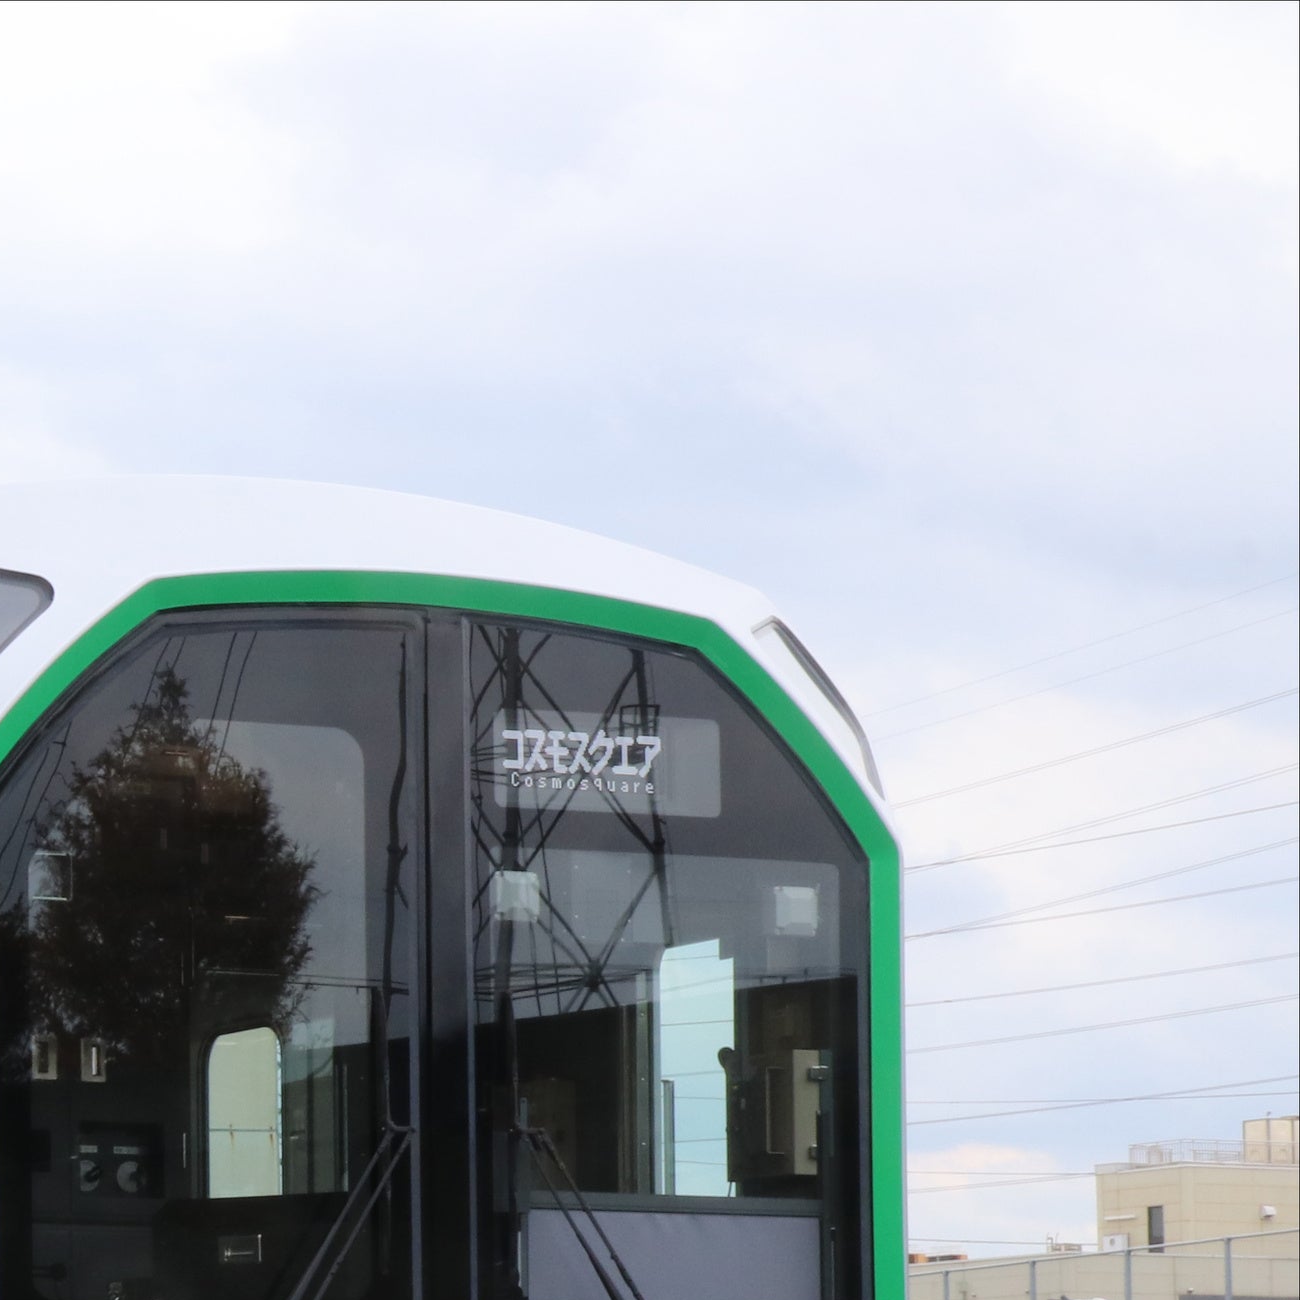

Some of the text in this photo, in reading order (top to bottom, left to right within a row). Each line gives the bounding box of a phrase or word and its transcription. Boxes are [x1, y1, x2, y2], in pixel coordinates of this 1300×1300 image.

[502, 729, 662, 778] コスモスクエア
[511, 772, 655, 794] Cosmosquare
